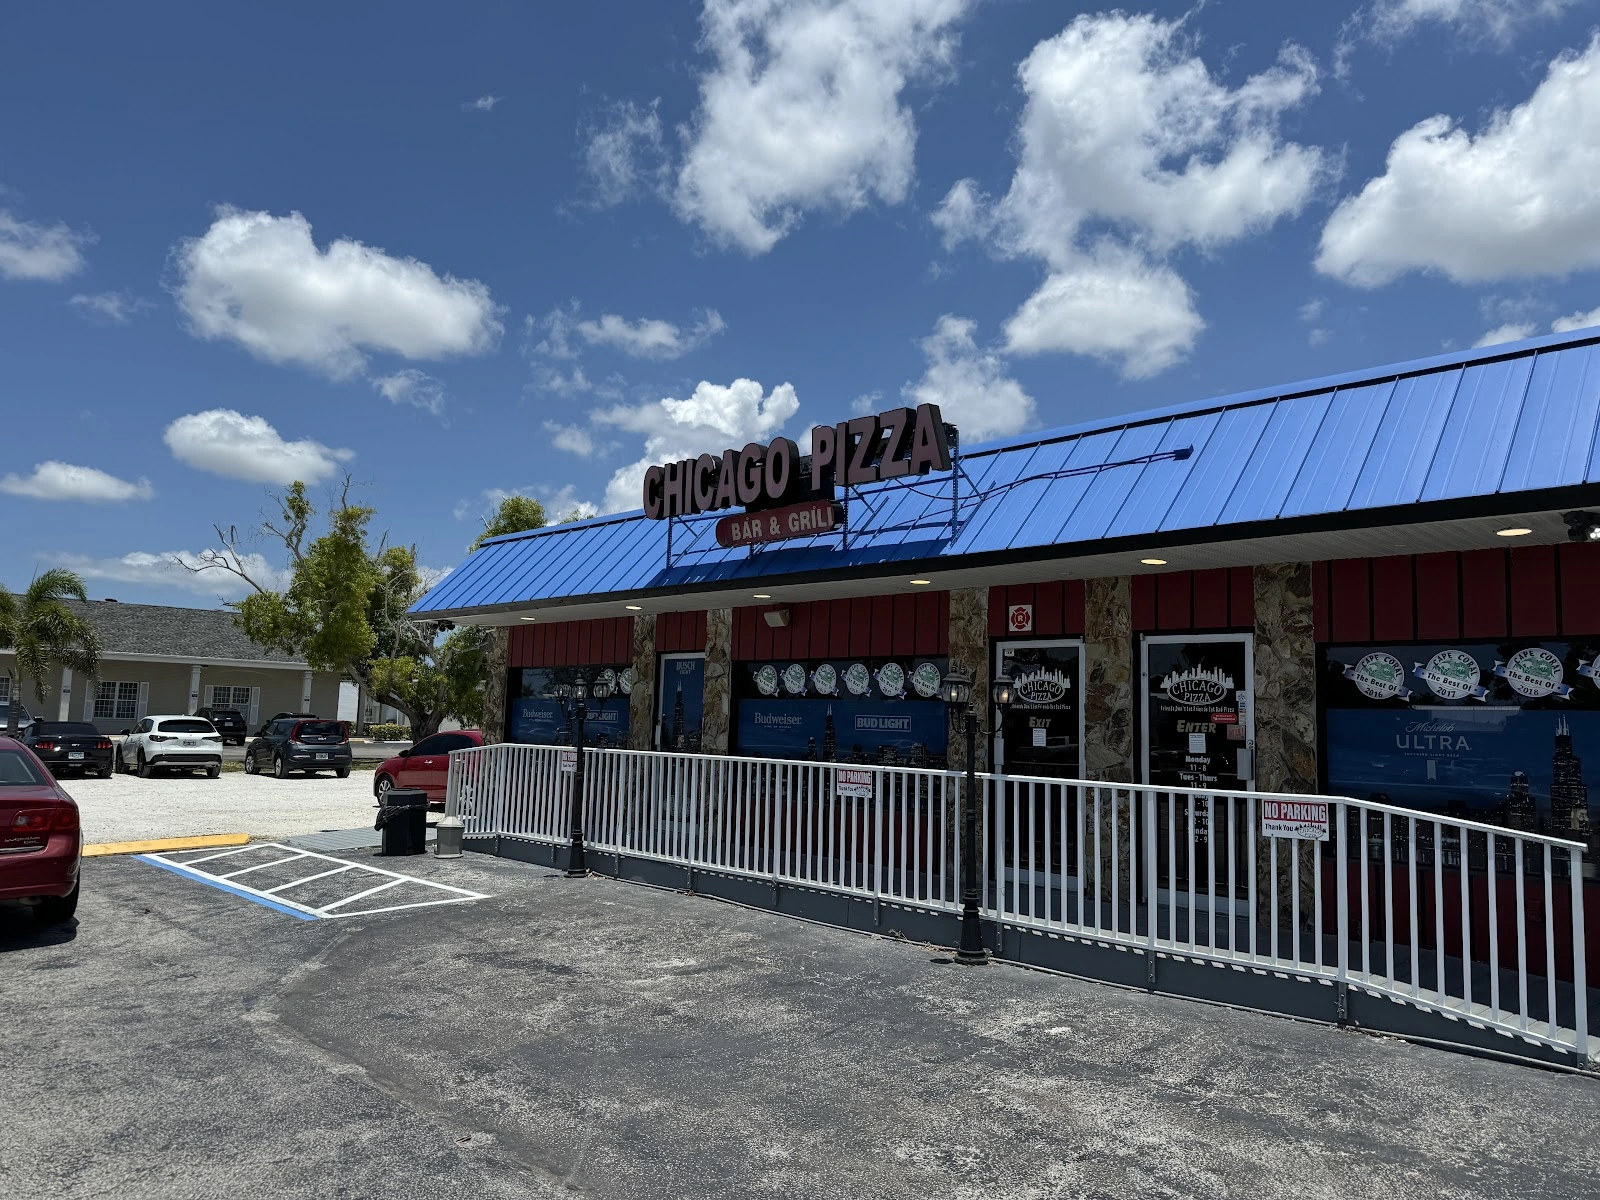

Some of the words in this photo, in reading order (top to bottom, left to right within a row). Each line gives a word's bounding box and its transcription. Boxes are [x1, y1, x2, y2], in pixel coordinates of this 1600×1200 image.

[643, 437, 799, 519] CHICAGO
[811, 403, 949, 491] PIZZA
[731, 519, 762, 541] BAR
[769, 516, 780, 535] &
[788, 507, 834, 532] GRILL
[676, 661, 696, 670] BUSCH
[1362, 654, 1379, 668] CAPE
[1384, 656, 1402, 677] CORAL
[1433, 652, 1453, 666] CAPE
[1458, 654, 1478, 676] CORAL
[1514, 650, 1535, 664] CAPE
[1540, 652, 1561, 674] CORAL
[1356, 674, 1368, 682] The
[1370, 678, 1386, 688] Best
[1388, 684, 1398, 692] Of
[1427, 672, 1440, 682] The
[1442, 678, 1460, 688] Best
[1462, 684, 1472, 692] Of
[1508, 670, 1522, 680] The
[1524, 675, 1543, 686] Best
[1021, 681, 1062, 695] CHICAGO
[1172, 680, 1222, 696] CHICAGO
[1364, 688, 1383, 698] 2016
[1437, 686, 1456, 698] 2017
[1517, 684, 1539, 696] 2018
[1030, 692, 1052, 700] PIZZA
[1184, 692, 1210, 702] PIZZA
[754, 712, 802, 724] Budweiser
[857, 718, 878, 728] BUD
[879, 718, 910, 730] LIGHT
[1405, 722, 1456, 732] Michelob
[1396, 734, 1471, 750] ULTRA
[1186, 755, 1211, 764] Monday
[1190, 764, 1196, 772] 11
[838, 770, 846, 782] NO
[847, 771, 871, 784] PARKING
[1180, 773, 1194, 781] Tues
[1198, 774, 1218, 782] Thurs
[1264, 802, 1278, 818] NO
[1281, 803, 1326, 821] PARKING
[1265, 823, 1282, 831] Thank
